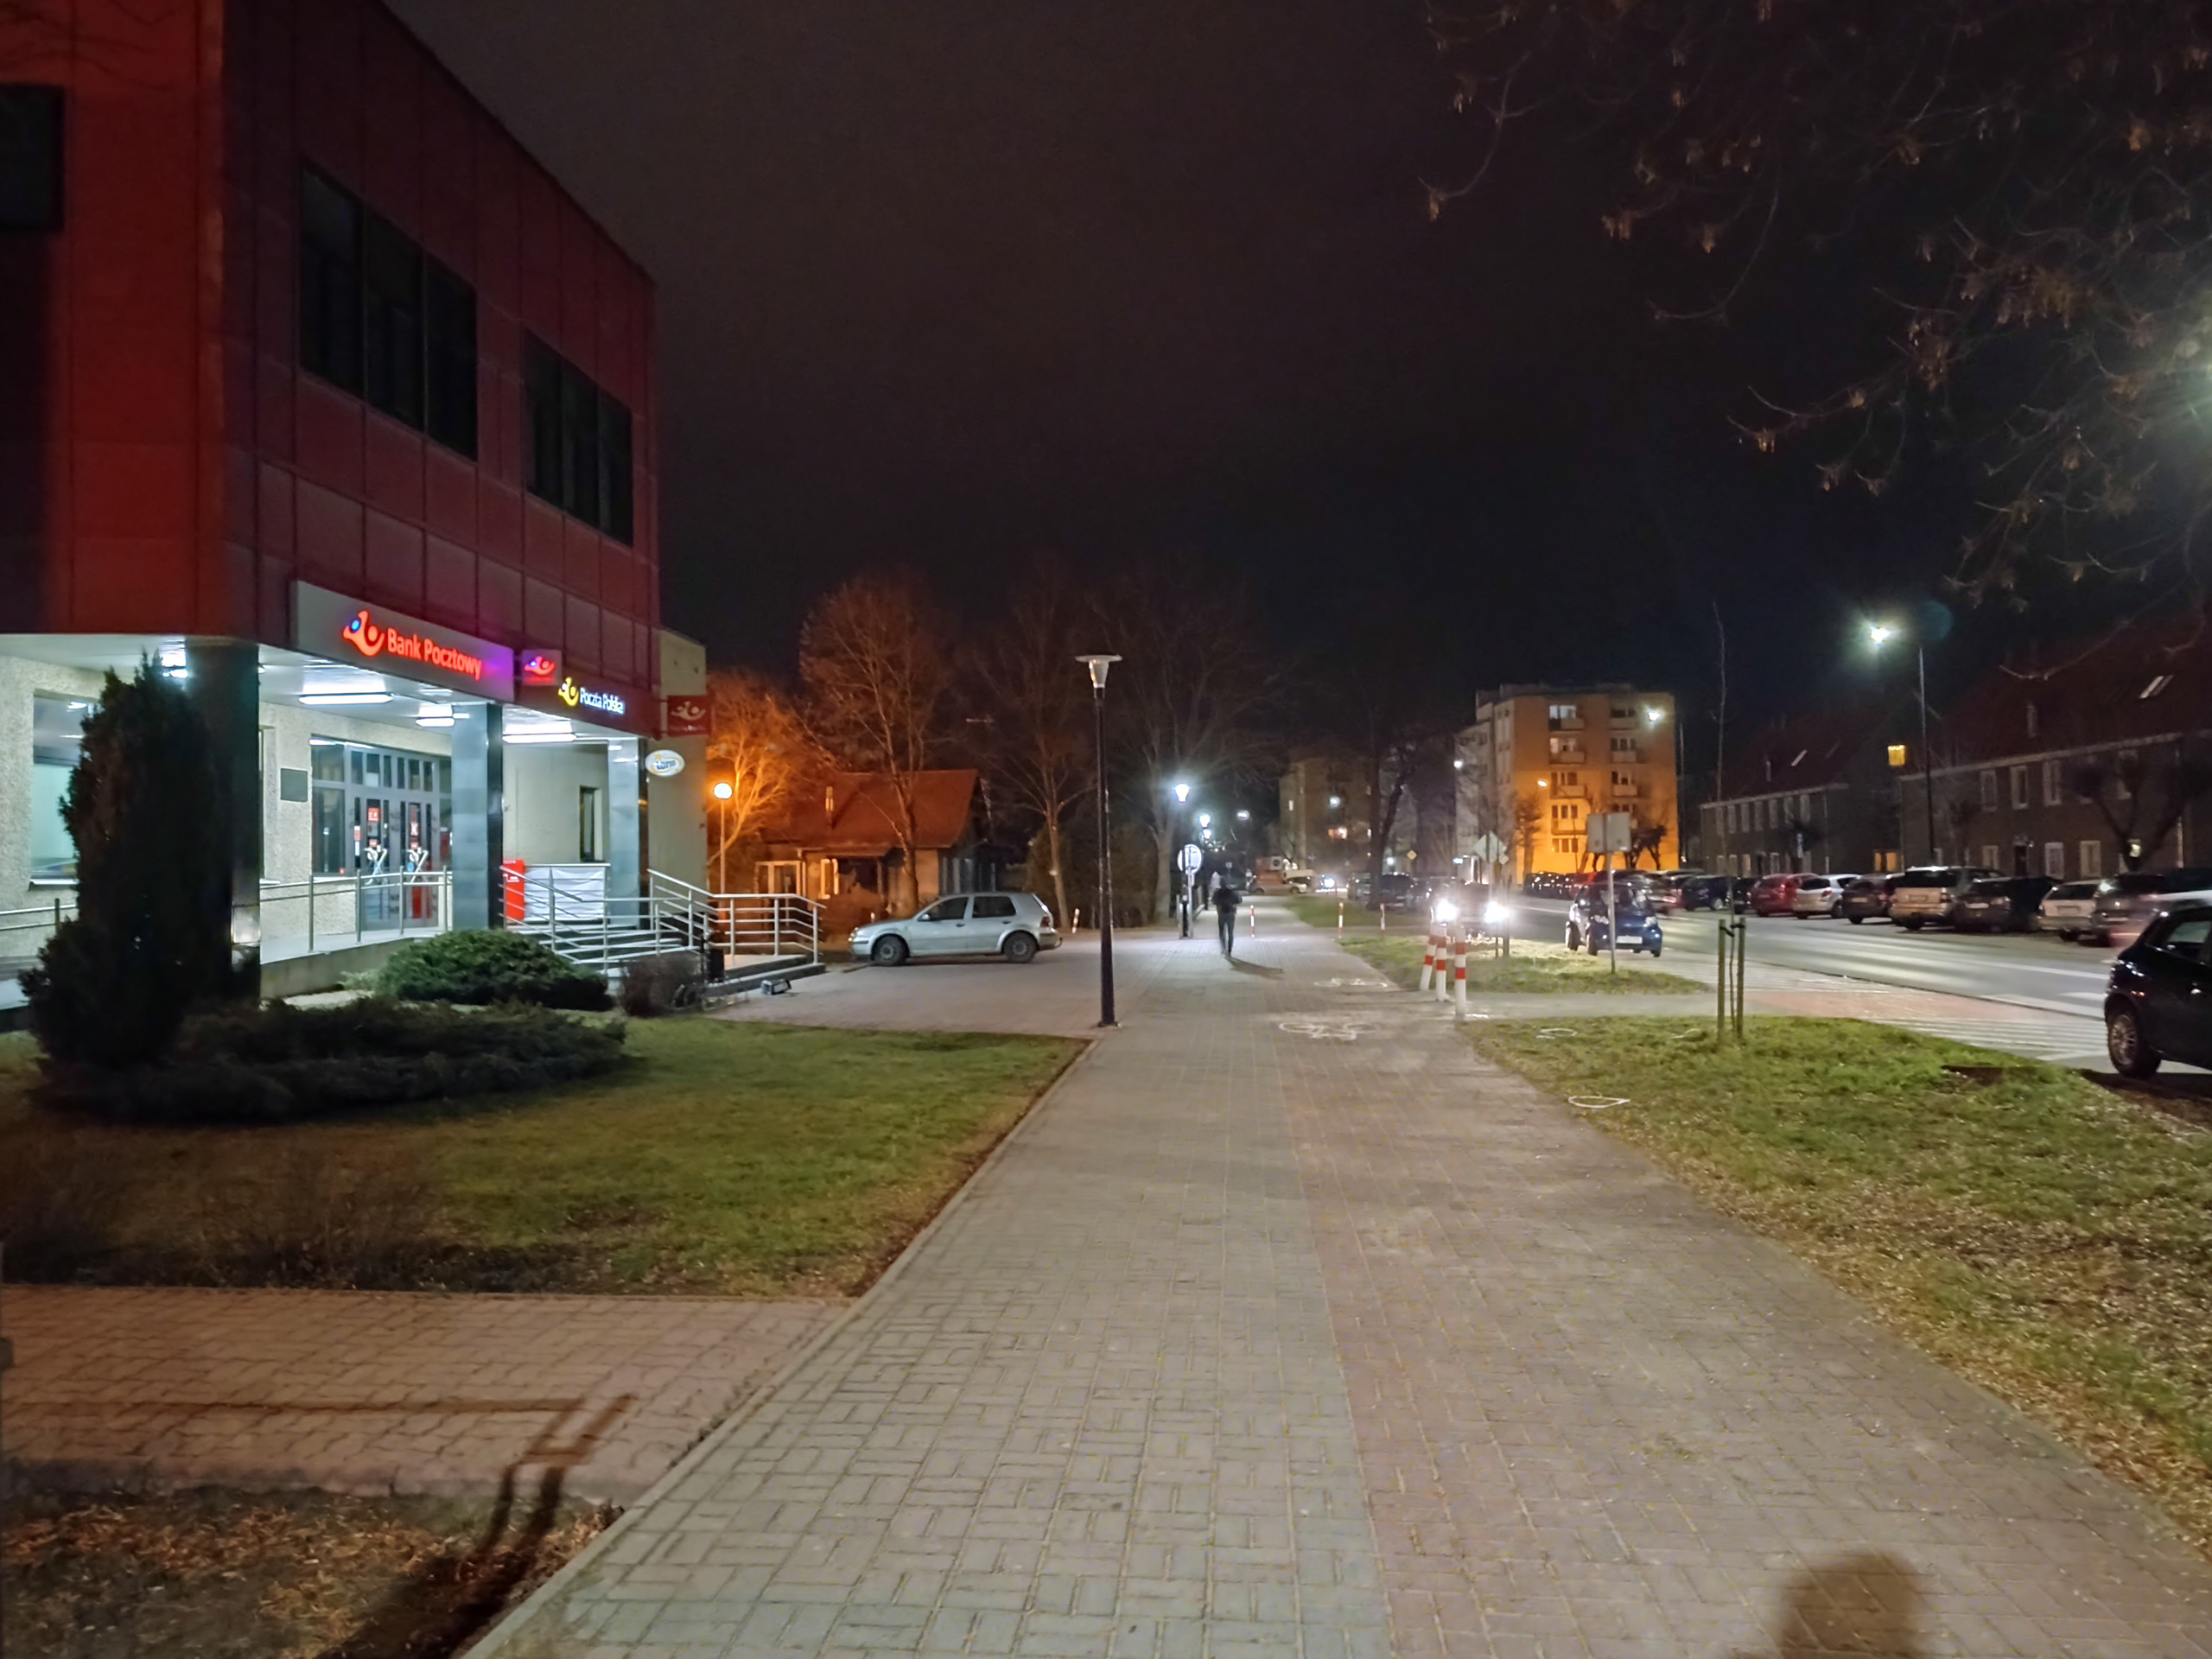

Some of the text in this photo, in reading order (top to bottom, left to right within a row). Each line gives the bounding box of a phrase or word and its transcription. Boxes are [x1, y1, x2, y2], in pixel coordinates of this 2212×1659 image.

[387, 627, 482, 681] Bank Pocztowy
[580, 687, 602, 709] Poczta
